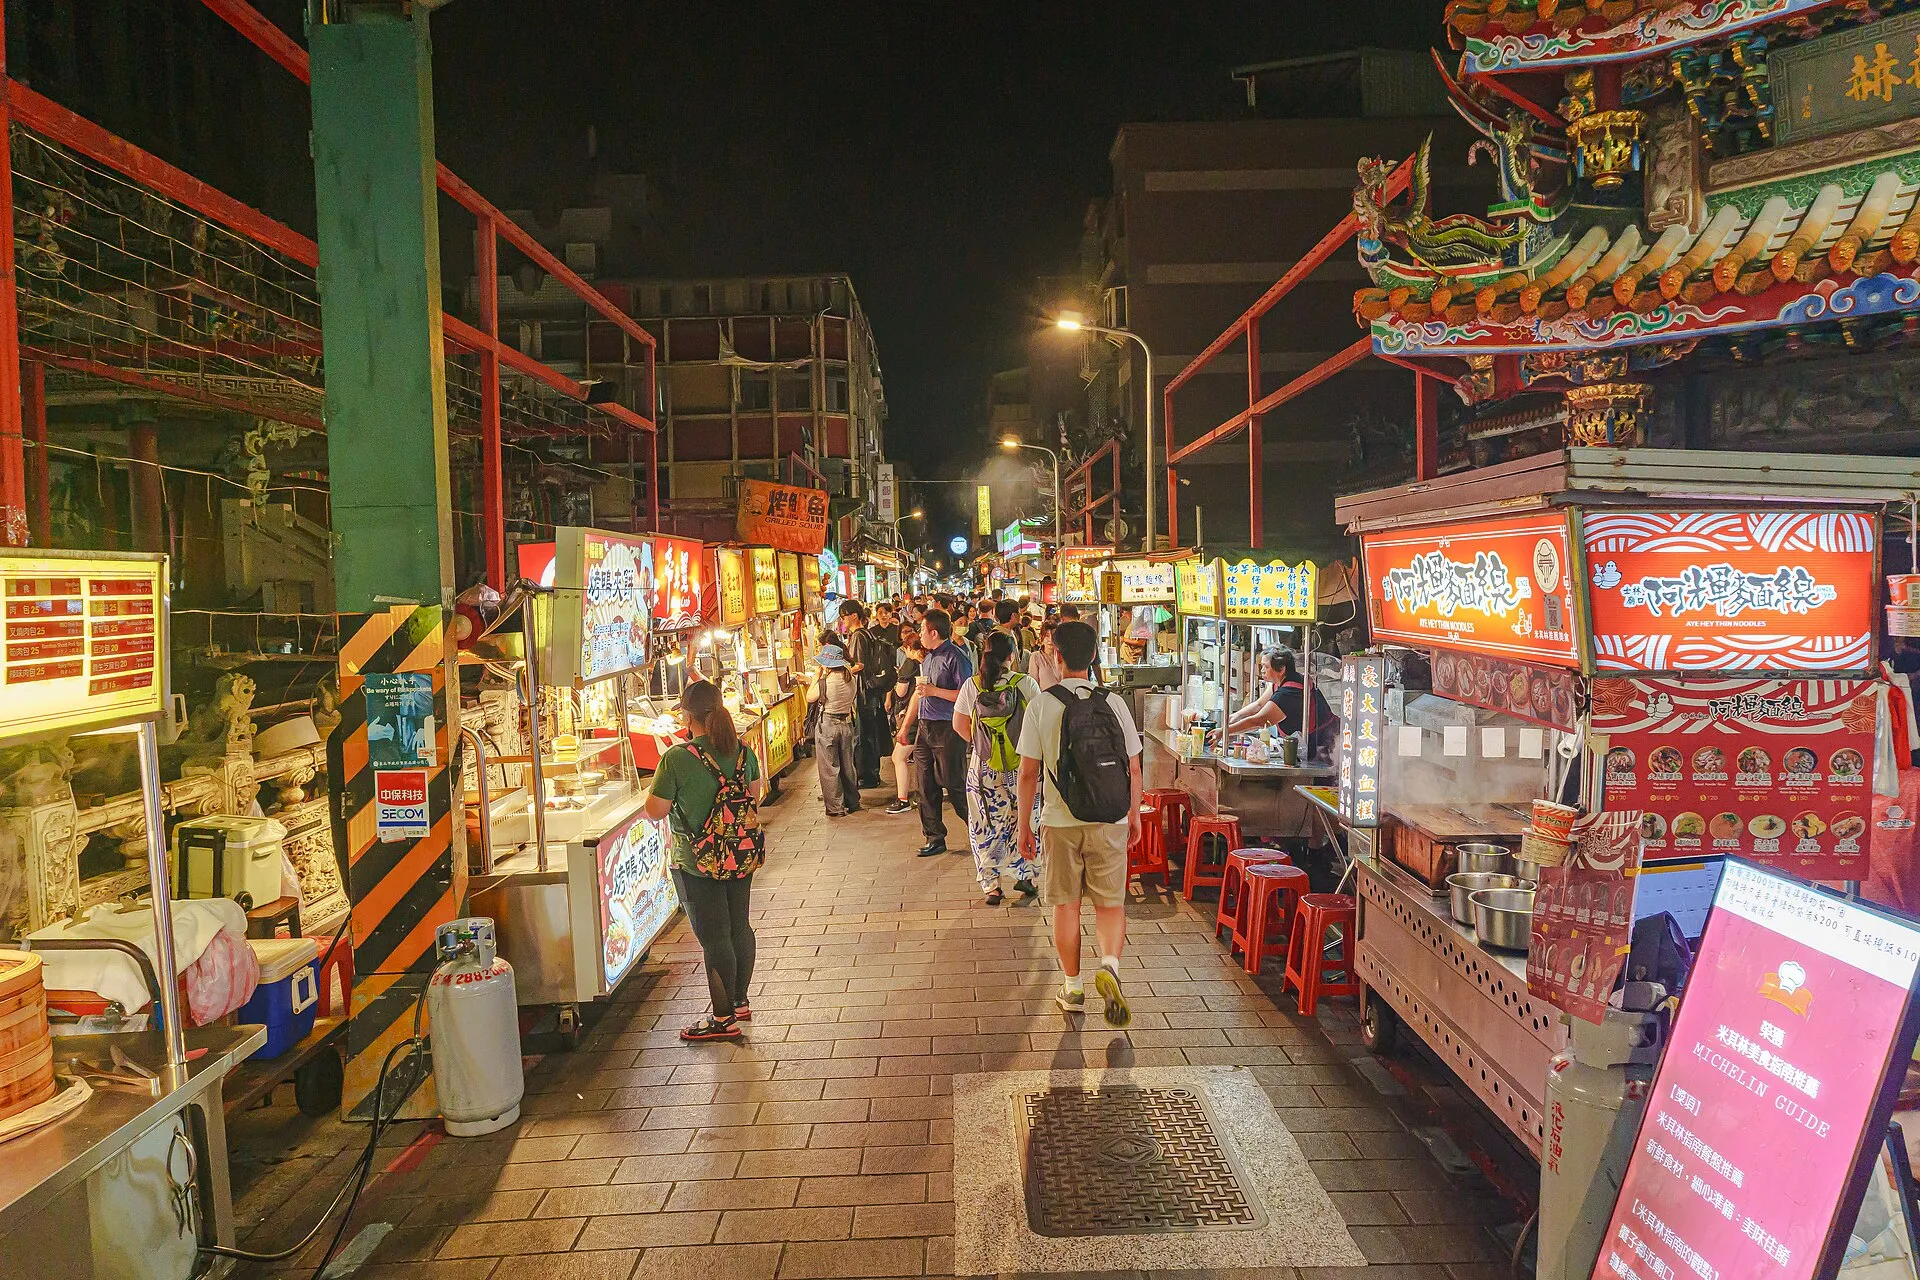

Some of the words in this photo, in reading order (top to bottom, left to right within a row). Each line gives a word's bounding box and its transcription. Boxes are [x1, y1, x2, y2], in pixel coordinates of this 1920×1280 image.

[765, 516, 796, 526] GRILLED
[589, 568, 634, 601] 烤鴨夾餅
[1391, 552, 1521, 614] 阿輝麵線
[1643, 564, 1823, 615] 阿輝麵線
[31, 605, 39, 614] 25
[1428, 619, 1438, 628] HEY
[1438, 620, 1450, 630] THIN
[1450, 621, 1474, 633] NOODLES
[1708, 693, 1807, 722] 阿輝麵線
[1356, 665, 1379, 820] 豪大支豬血糕
[381, 790, 423, 800] 中保科技
[382, 809, 423, 819] SECOM
[613, 833, 659, 896] 烤鴨夾餅
[1759, 1020, 1786, 1048] 榮獲
[1716, 1024, 1821, 1099] 米其林美食指南推薦
[1692, 1042, 1769, 1098] MICHELIN
[1774, 1094, 1830, 1138] GUIDE
[1656, 1110, 1744, 1188] 米其林指南餐盤推薦
